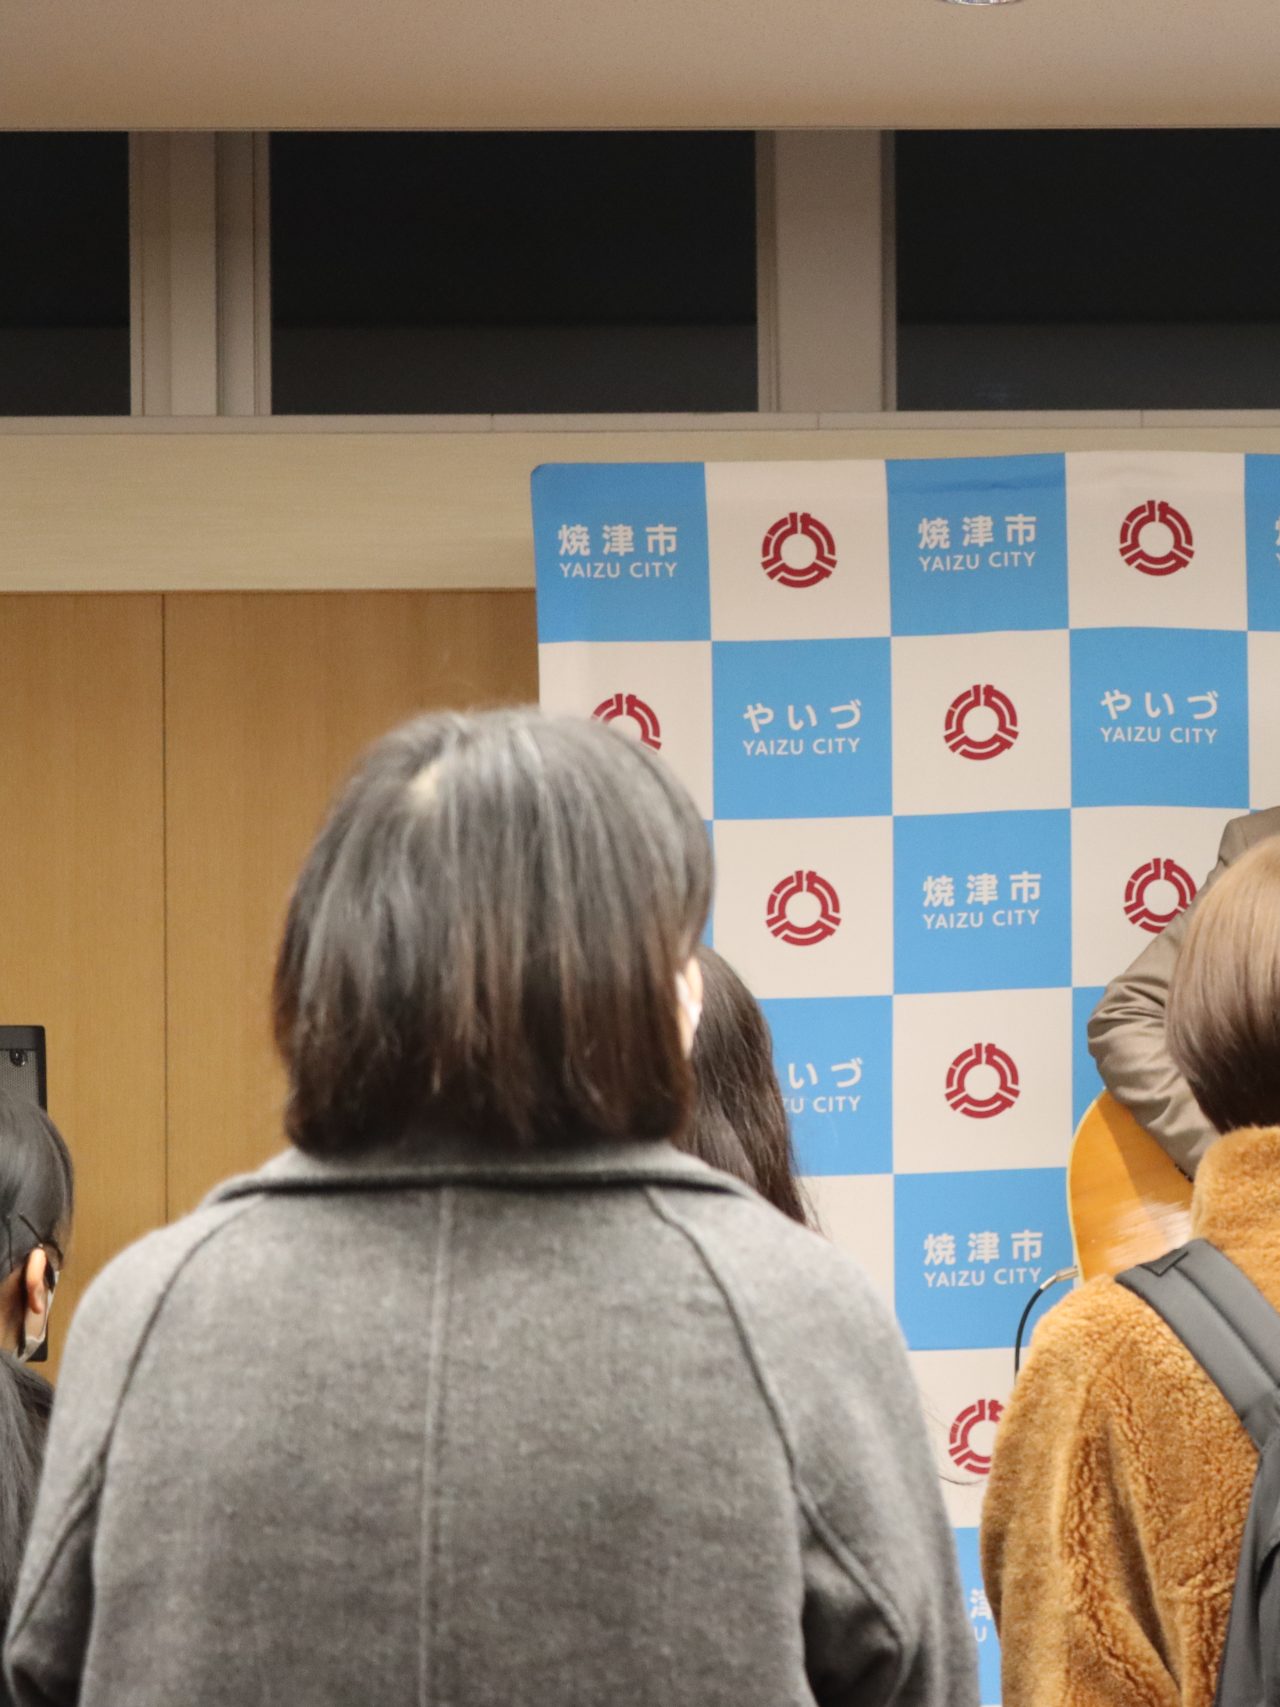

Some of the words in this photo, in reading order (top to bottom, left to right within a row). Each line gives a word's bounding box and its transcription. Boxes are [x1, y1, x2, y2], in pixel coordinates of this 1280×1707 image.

[556, 521, 680, 558] 焼津市
[916, 513, 1040, 552] 焼津市
[559, 560, 623, 581] YAIZU
[627, 559, 678, 580] CITY
[917, 552, 983, 574] YAIZU
[987, 549, 1037, 570] CITY
[741, 698, 862, 734] やいづ
[1099, 688, 1219, 721] やいづ
[743, 737, 805, 757] YAIZU
[811, 736, 860, 756] CITY
[1100, 725, 1162, 744] YAIZU
[1169, 726, 1217, 744] CITY
[922, 871, 1041, 909] 焼津市
[923, 911, 985, 929] YAIZU
[991, 908, 1040, 927] CITY
[787, 1056, 863, 1089] いづ
[812, 1094, 862, 1114] CITY
[923, 1228, 1044, 1266] 焼津市
[923, 1269, 986, 1288] YAIZU
[993, 1267, 1043, 1287] CITY
